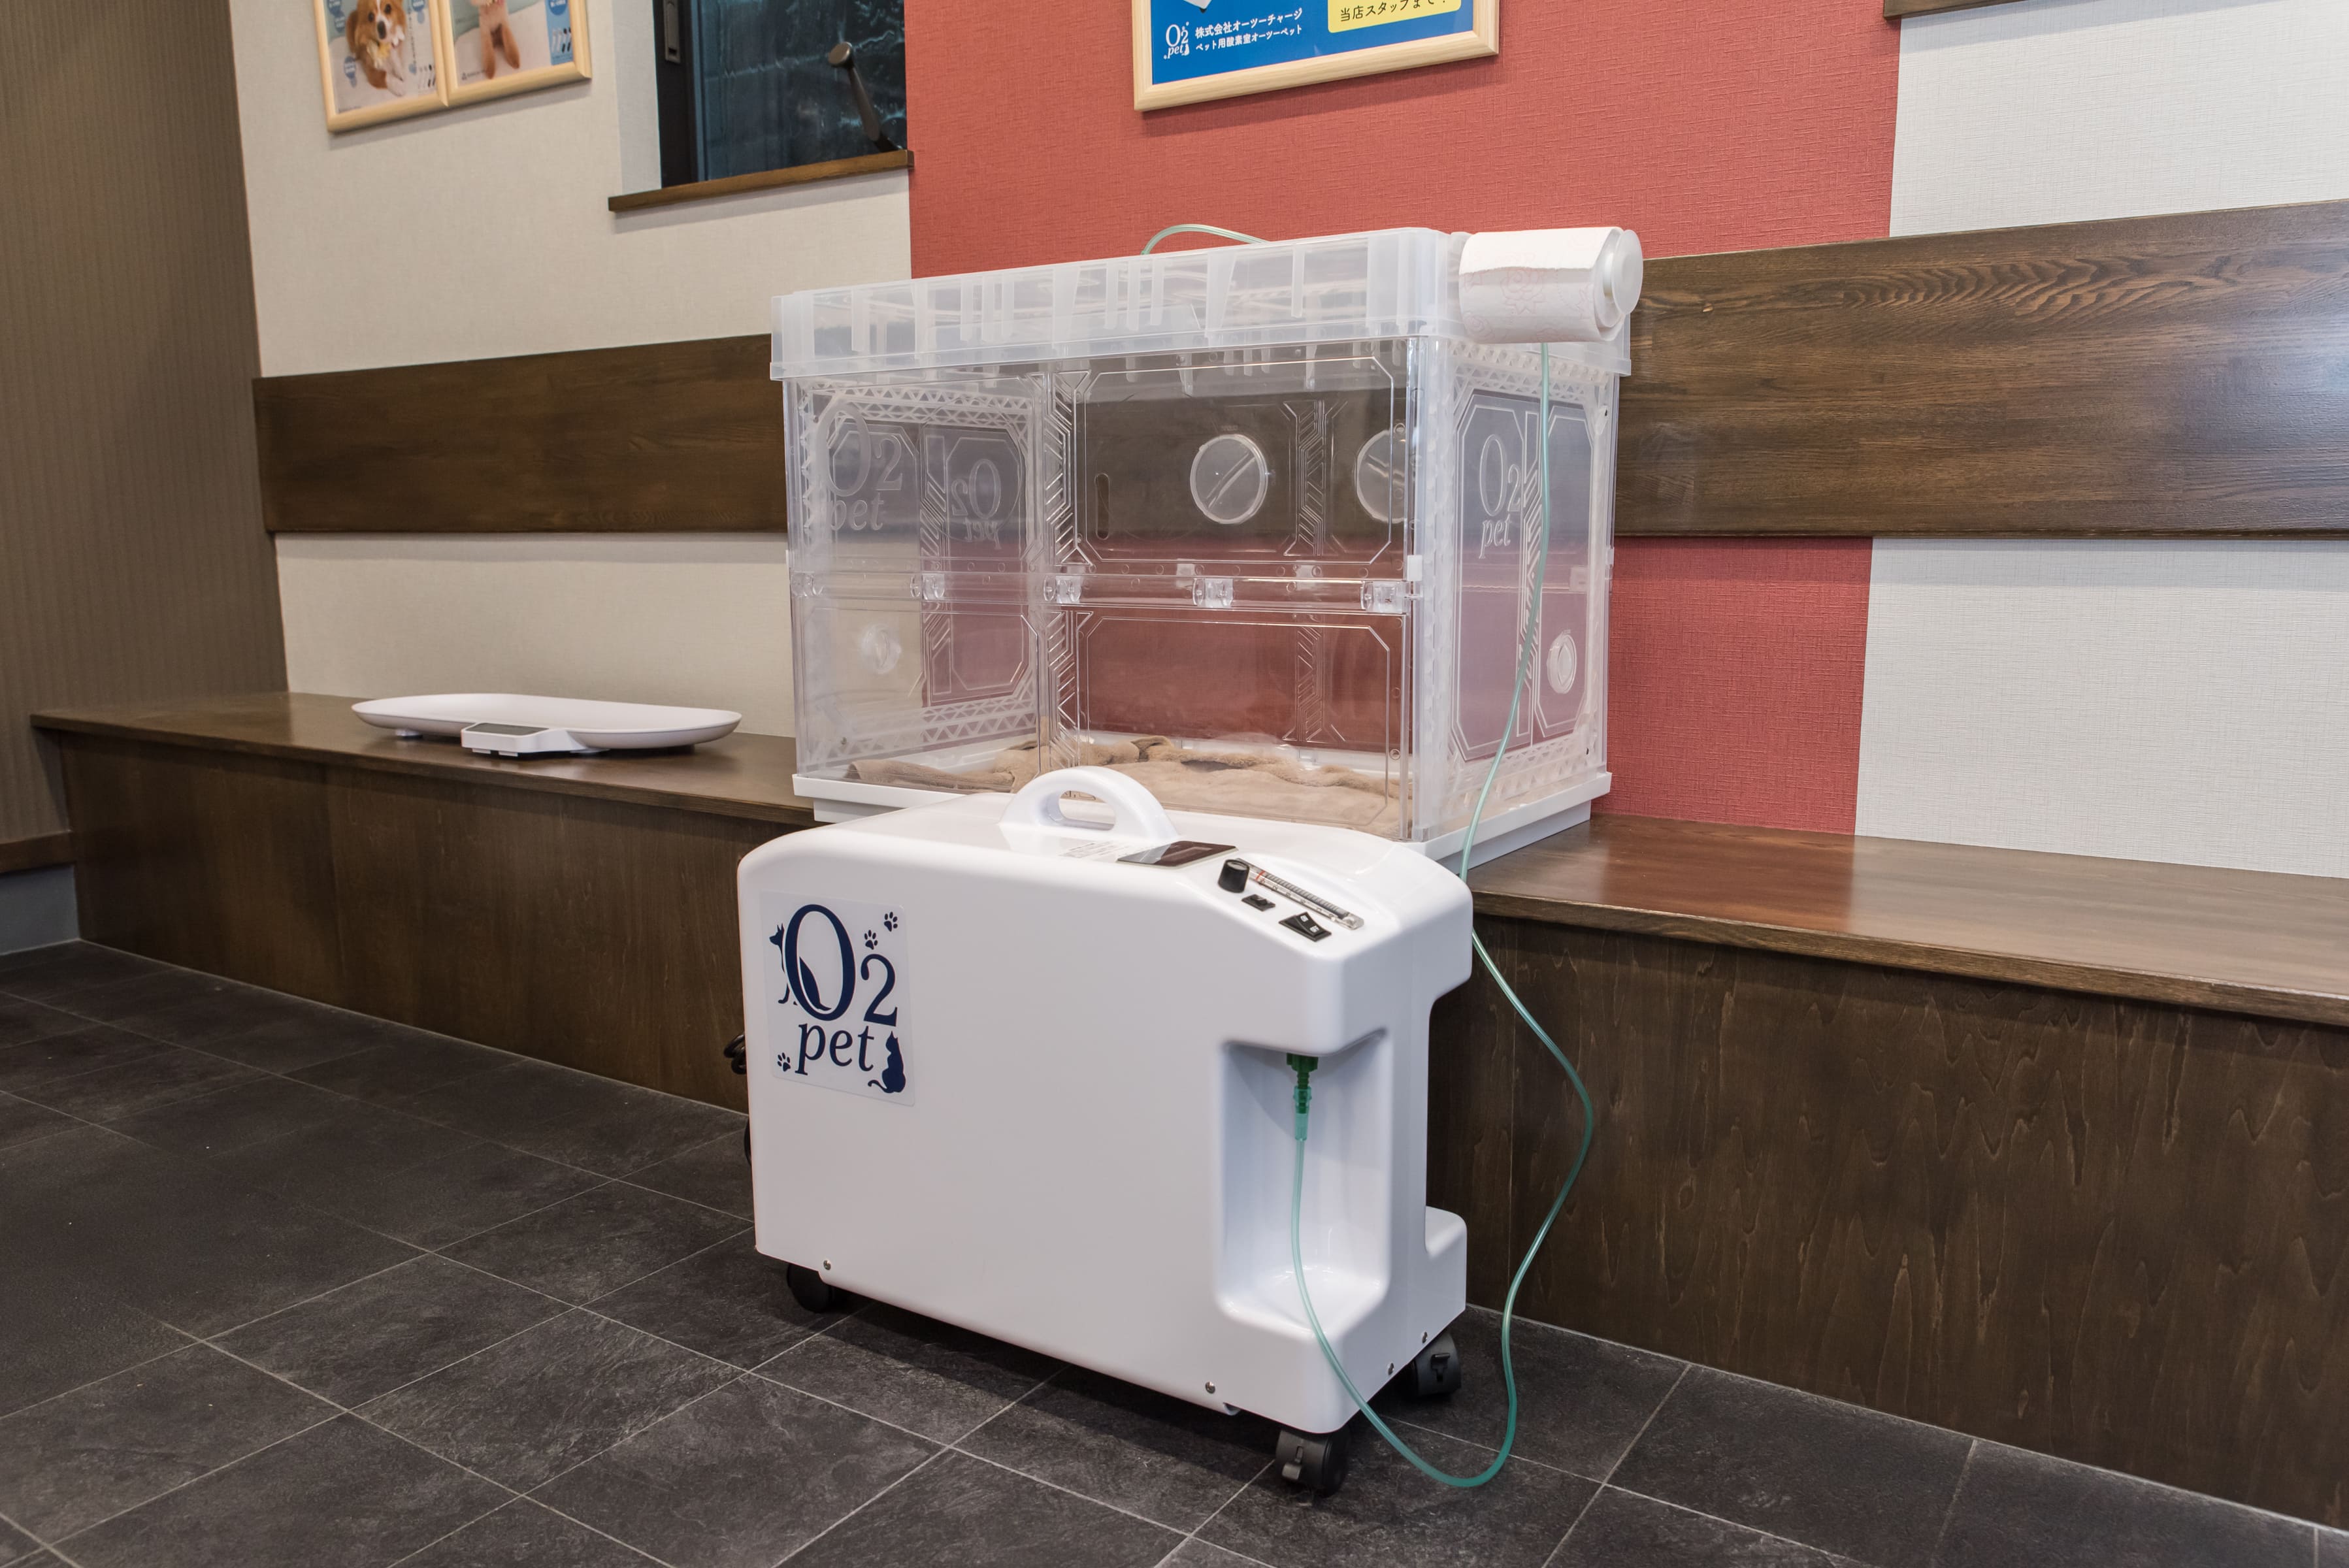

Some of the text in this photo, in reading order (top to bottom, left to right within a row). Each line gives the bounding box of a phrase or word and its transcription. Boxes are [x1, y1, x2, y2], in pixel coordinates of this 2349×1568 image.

[1195, 7, 1302, 39] 株式会社オーツーチャージ
[1340, 0, 1445, 22] 当店スタッフま
[1166, 24, 1189, 47] O2
[1167, 44, 1183, 59] pet
[1196, 24, 1302, 51] ペット用酸素室オーツーペット
[815, 400, 903, 497] O2
[1479, 434, 1521, 517] O2
[1479, 512, 1512, 559] pet
[785, 904, 898, 1027] O2
[795, 1022, 874, 1076] pet
